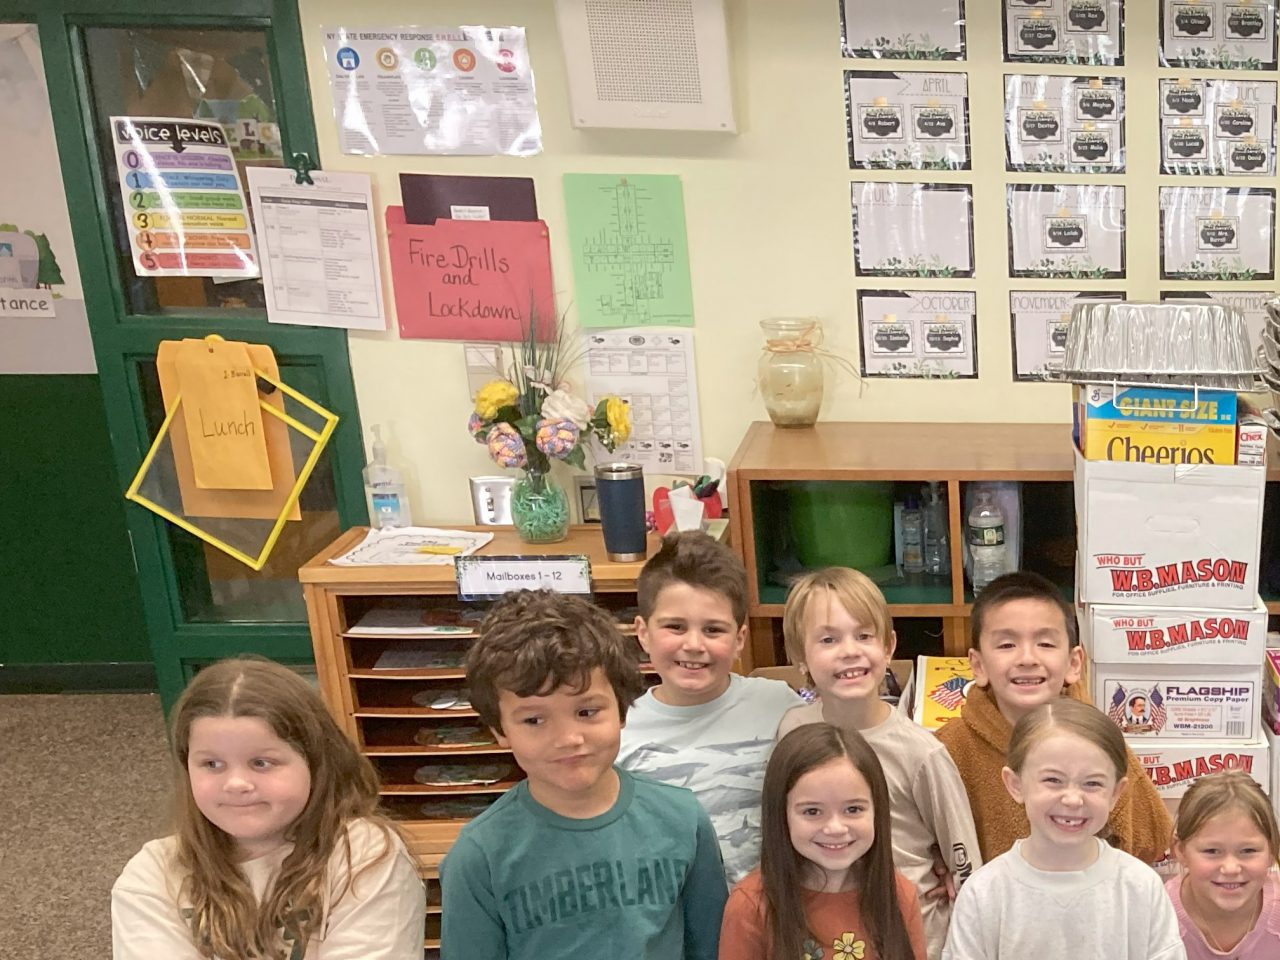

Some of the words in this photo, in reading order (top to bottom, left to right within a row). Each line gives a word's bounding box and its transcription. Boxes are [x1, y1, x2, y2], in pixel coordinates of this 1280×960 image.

[326, 33, 336, 41] NY
[359, 33, 398, 41] EMERGENCY
[400, 33, 433, 41] RESPONSE
[922, 78, 950, 93] APRIL
[175, 125, 222, 144] levels
[132, 173, 141, 188] 1
[133, 192, 146, 212] 2
[137, 213, 149, 228] 3
[140, 233, 152, 248] 4
[144, 254, 156, 268] 5
[409, 238, 449, 268] Fire
[450, 244, 510, 274] Drills
[442, 268, 480, 286] and
[428, 291, 521, 320] Lockdown
[920, 295, 971, 312] OCTOBER
[1013, 296, 1069, 311] NOVEMBER
[1119, 396, 1177, 417] GIANT
[1180, 400, 1218, 420] SIZE
[198, 407, 255, 438] Lunch
[1240, 432, 1263, 442] Chex
[1106, 436, 1216, 465] Cheerios
[1097, 556, 1121, 566] WHO
[1123, 556, 1143, 566] BUT
[487, 572, 536, 582] Mailboxes
[552, 572, 562, 581] 12
[1111, 559, 1248, 592] W.B.MASON
[1178, 582, 1210, 591] FURNITURE
[1113, 619, 1135, 628] WHO
[1137, 619, 1154, 627] BUT
[1126, 617, 1250, 651] W.B.MASON
[1166, 686, 1250, 697] FLAGSHIP
[1143, 756, 1160, 765] BUT
